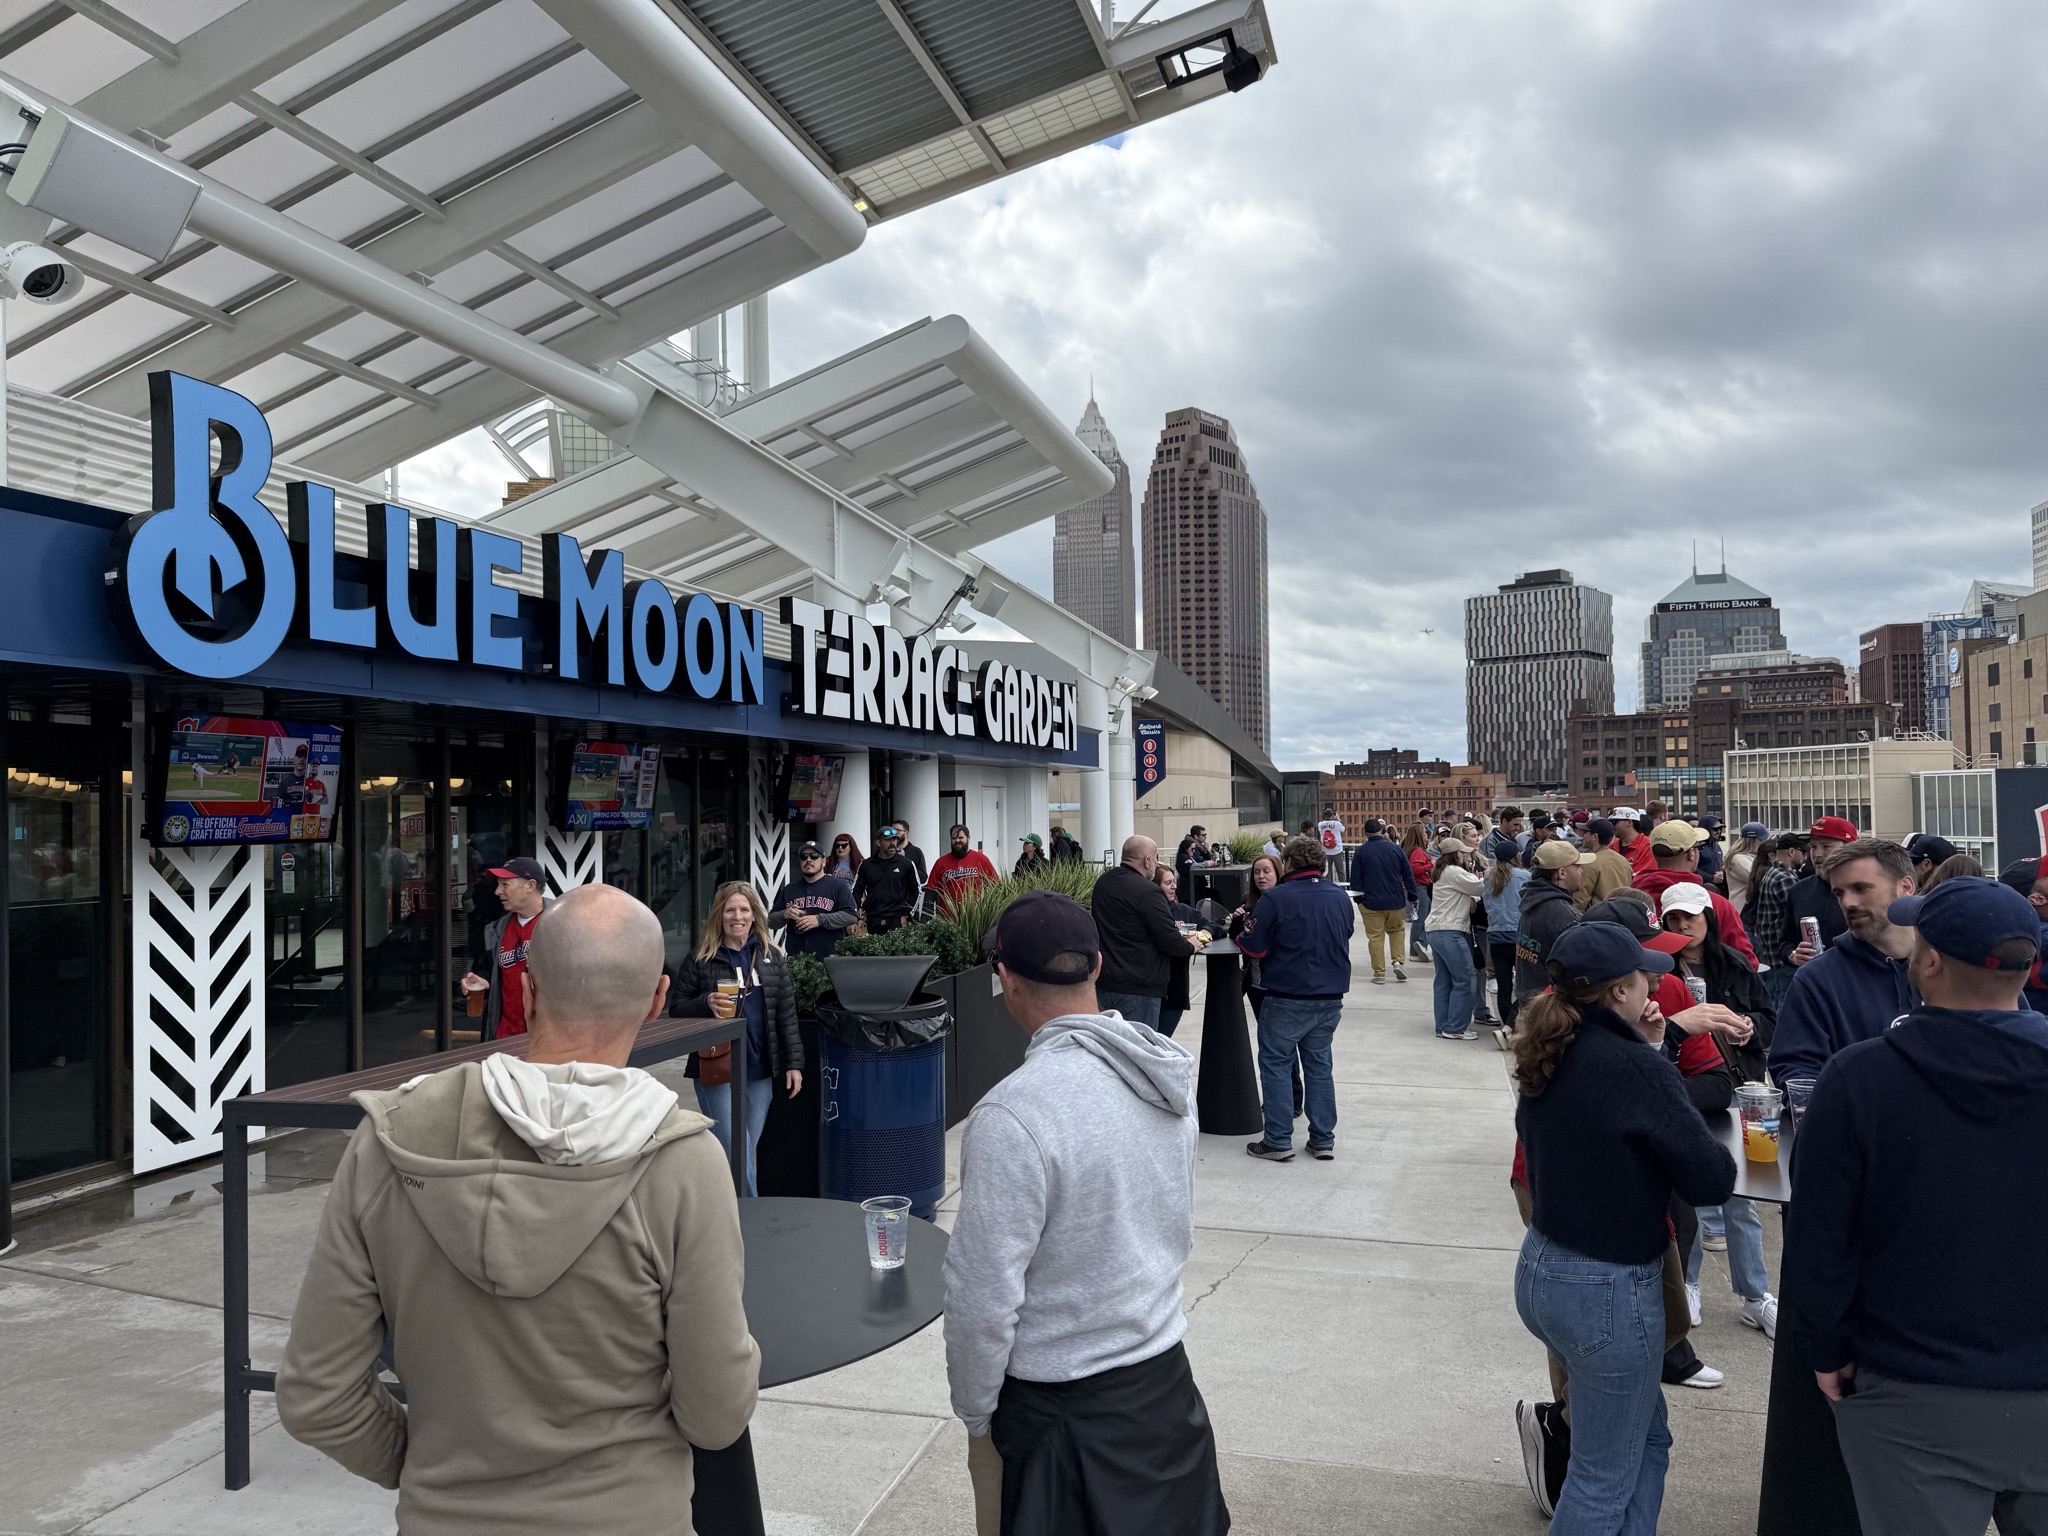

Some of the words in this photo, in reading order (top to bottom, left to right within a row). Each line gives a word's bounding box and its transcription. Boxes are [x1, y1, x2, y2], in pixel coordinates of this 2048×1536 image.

[127, 370, 523, 679] BLUE
[558, 533, 764, 705] MOON
[792, 597, 976, 736] TERRACE
[984, 659, 1078, 751] GARDEN
[1669, 603, 1696, 611] FIFTH
[1698, 601, 1730, 610] THIRD
[1731, 599, 1760, 608] BANK
[191, 818, 204, 829] THE
[204, 817, 238, 829] OFFICIAL
[567, 814, 588, 825] AXI
[190, 829, 213, 840] CRAFT
[214, 828, 232, 839] BEER
[943, 866, 979, 881] Indians
[877, 1225, 888, 1256] DOUBLE
